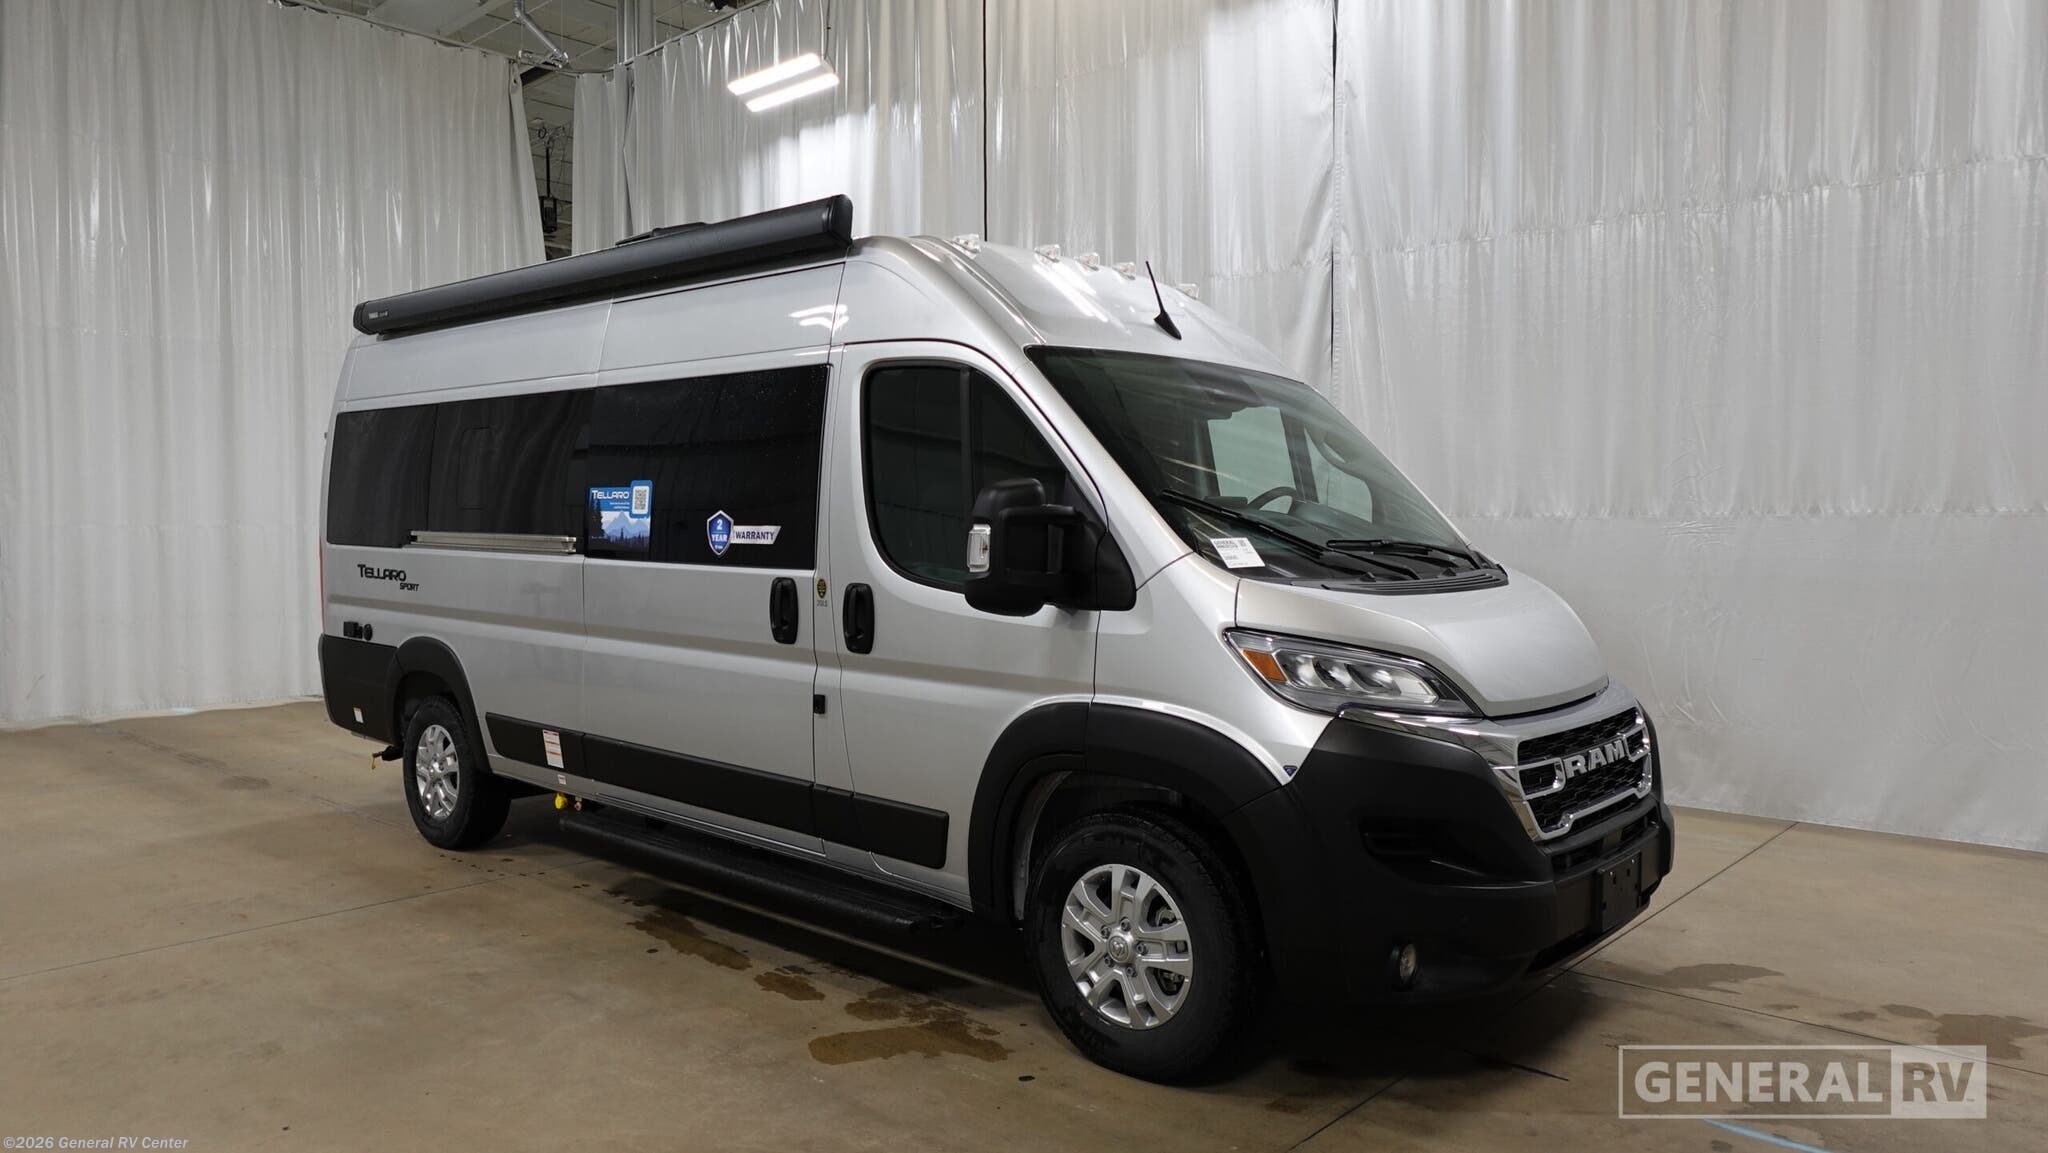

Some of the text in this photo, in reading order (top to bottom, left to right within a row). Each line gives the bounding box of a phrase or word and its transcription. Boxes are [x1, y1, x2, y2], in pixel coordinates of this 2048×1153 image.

[591, 490, 630, 499] TELLARO
[716, 519, 723, 531] 2
[711, 533, 728, 542] YEAR
[735, 531, 775, 540] WARRANTY
[357, 564, 407, 582] TELLARO
[399, 582, 420, 591] SPORT
[1563, 739, 1625, 779] RAM
